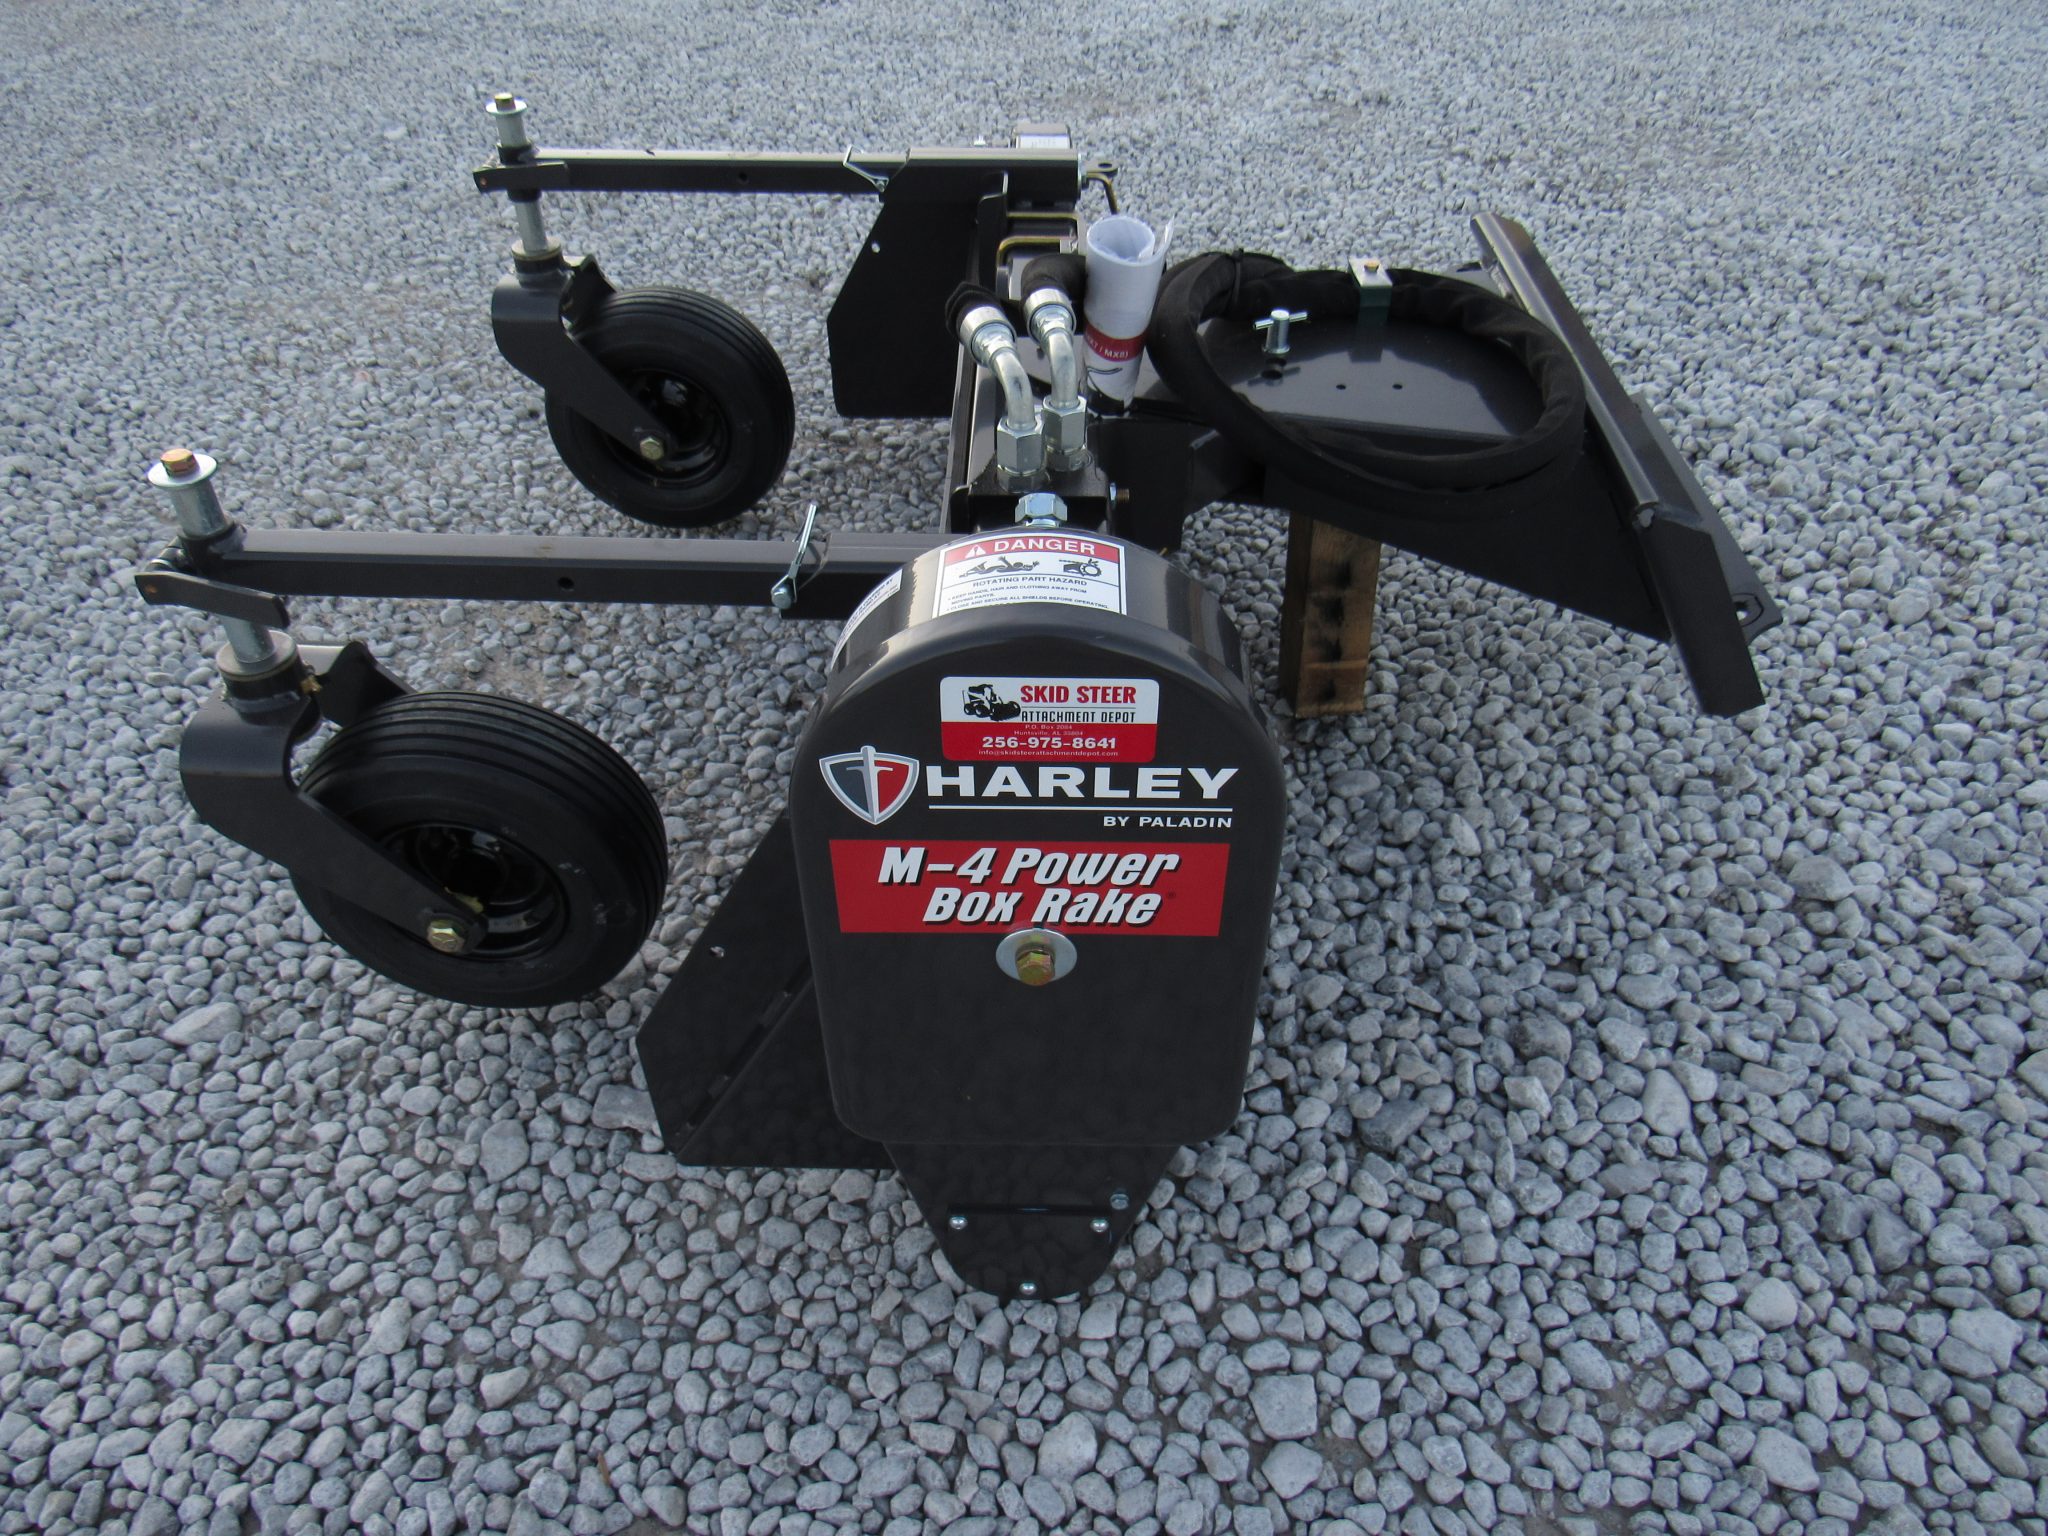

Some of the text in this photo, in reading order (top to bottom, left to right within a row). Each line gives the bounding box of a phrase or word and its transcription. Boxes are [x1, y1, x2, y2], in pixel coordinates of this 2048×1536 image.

[994, 538, 1095, 555] DANGER
[973, 576, 1019, 587] ROTATING
[1049, 576, 1087, 586] HAZARD
[1020, 685, 1137, 704] SKID STEER
[1021, 711, 1136, 723] ATTACHMENT DEPOT
[982, 736, 1116, 749] 256-975-8641
[978, 749, 1119, 758] info@skidsteerattachmentdepot.com
[926, 765, 1239, 800] HARLEY
[1103, 816, 1233, 828] BY PALADIN
[877, 847, 1181, 887] M-4 Power
[922, 887, 1163, 925] Box Rake
